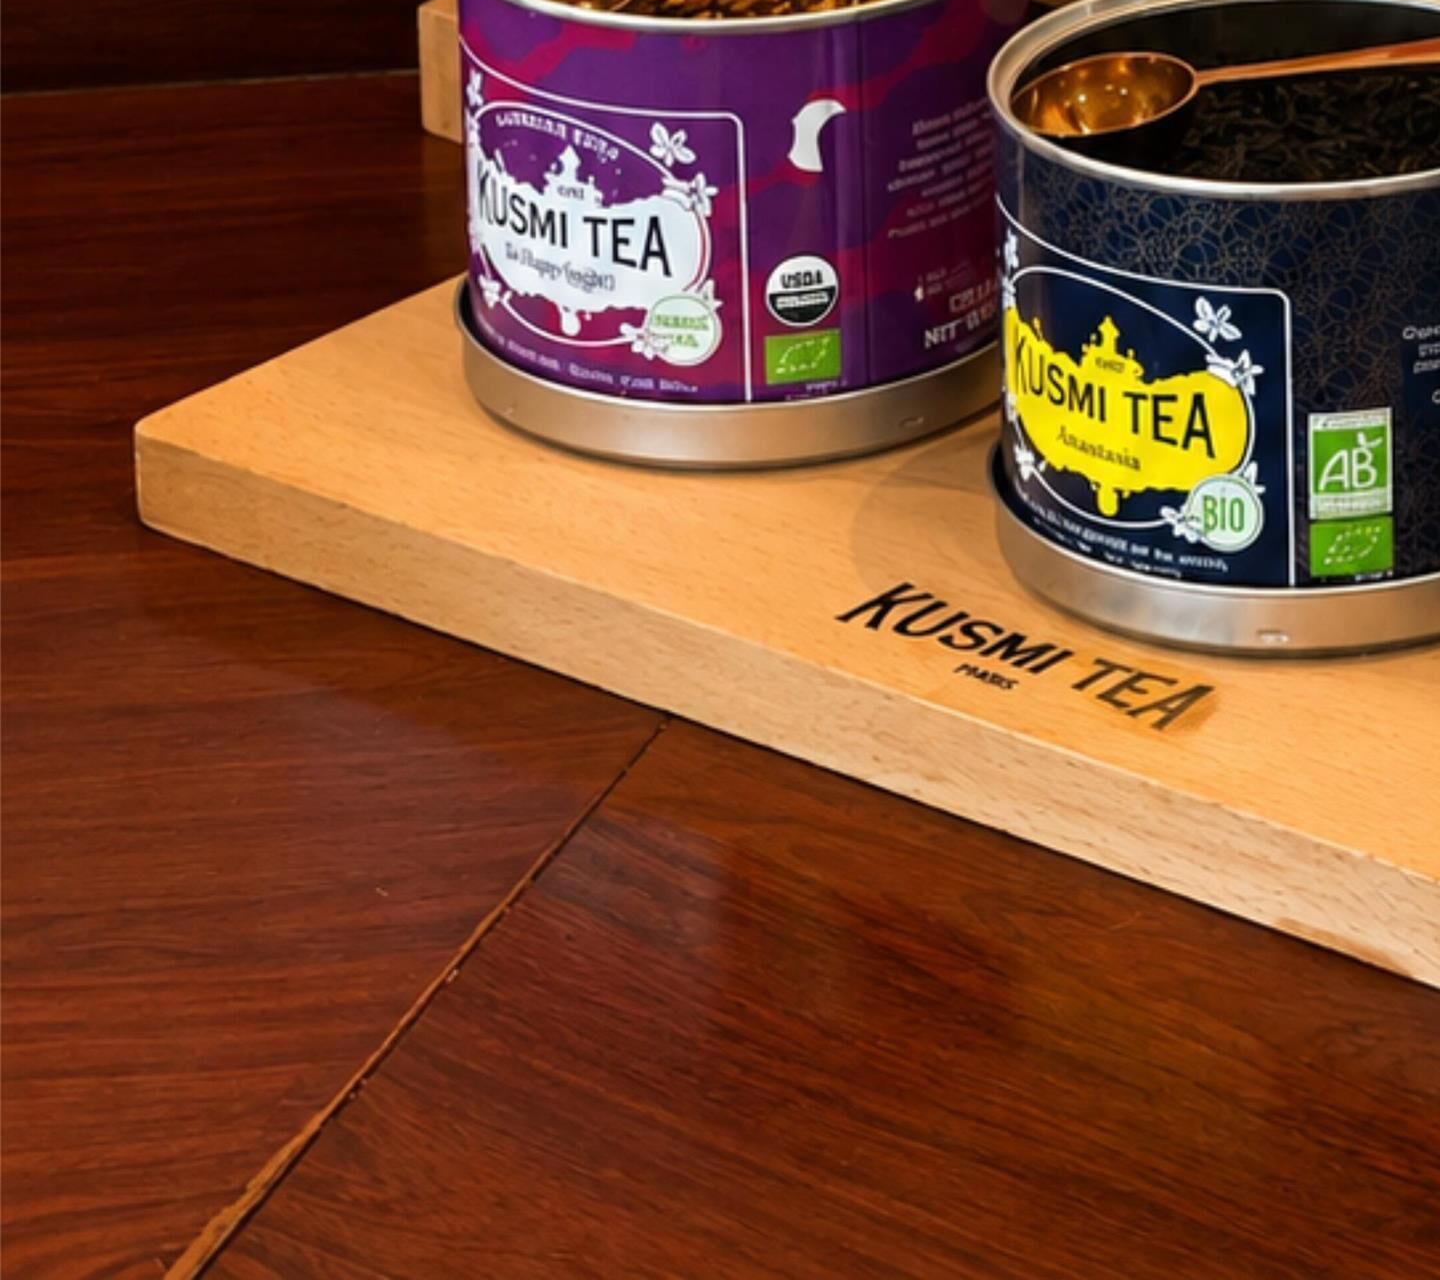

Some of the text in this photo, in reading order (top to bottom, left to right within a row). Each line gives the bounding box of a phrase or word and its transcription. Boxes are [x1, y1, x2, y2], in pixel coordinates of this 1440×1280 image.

[477, 159, 673, 279] KUSMI TEA
[1017, 336, 1217, 460] KUSMI TEA
[1056, 425, 1141, 473] Anastasia
[1318, 447, 1378, 492] AB
[1202, 493, 1246, 534] BIO
[834, 581, 1216, 732] KUSMI TEA
